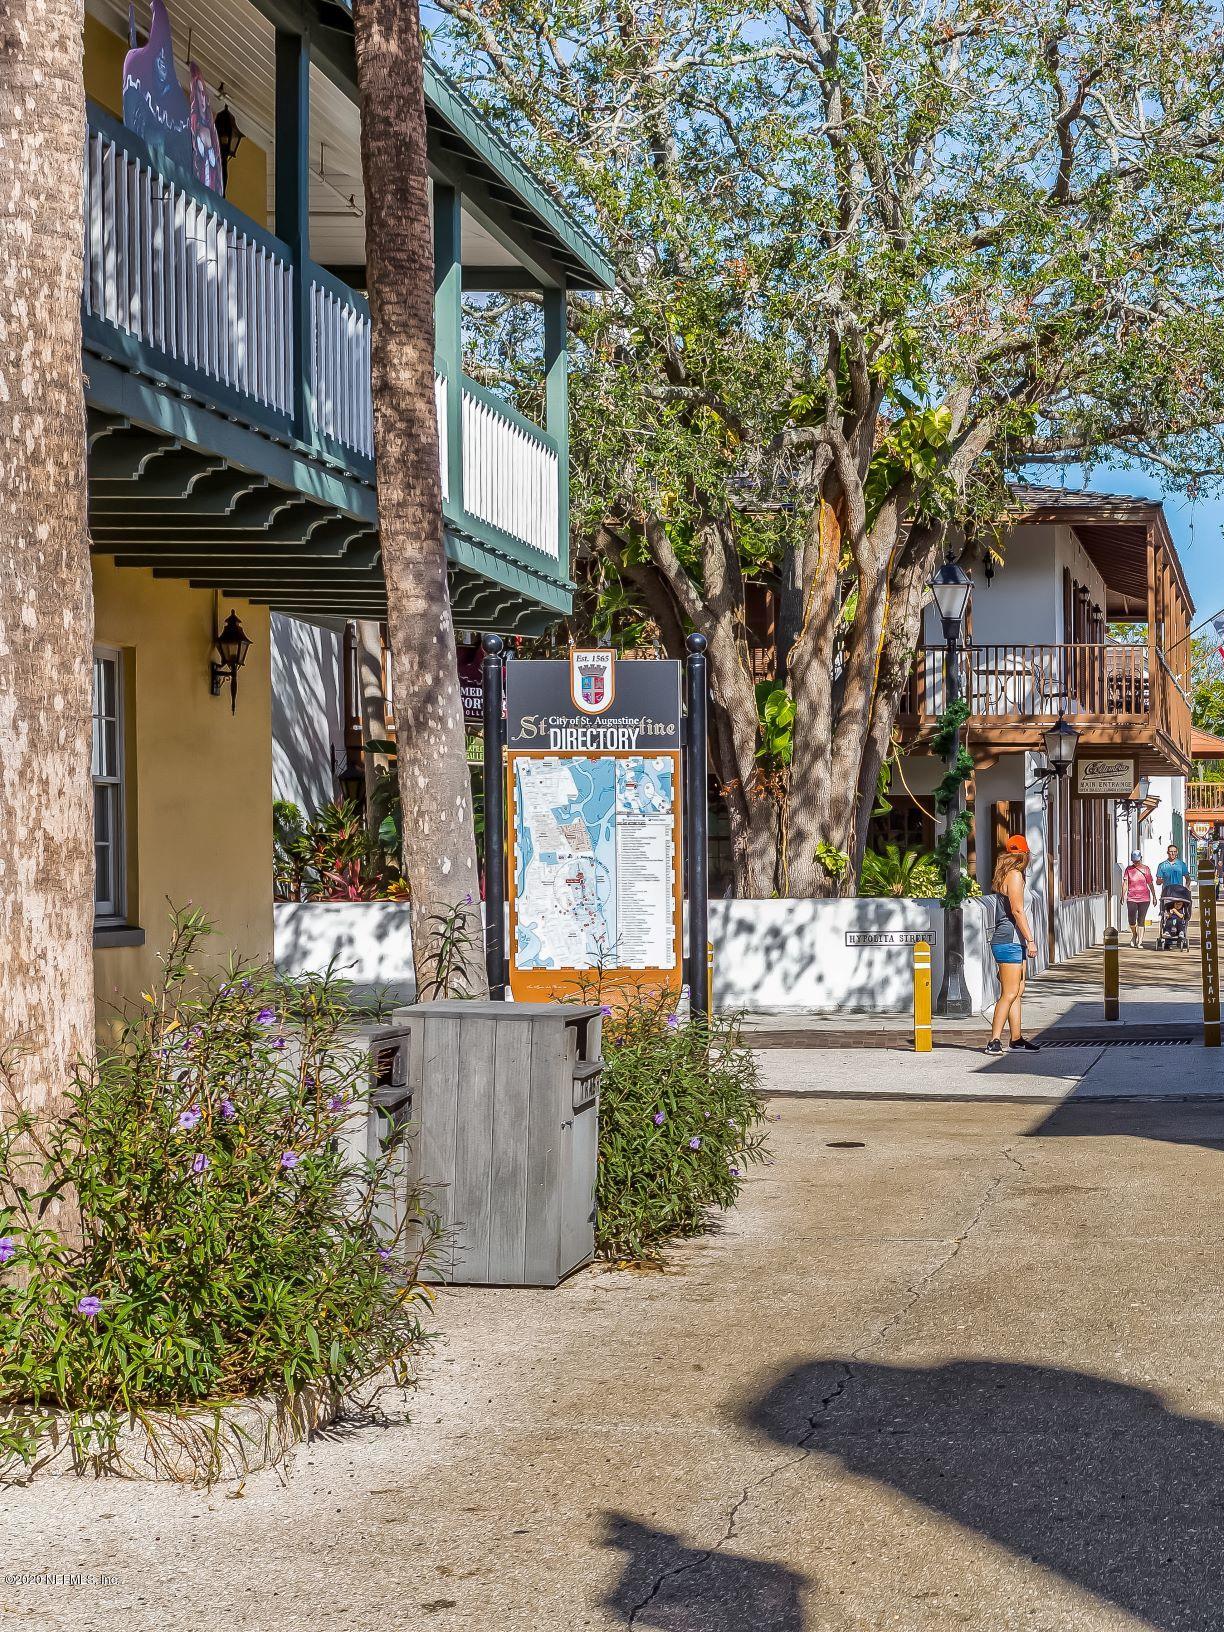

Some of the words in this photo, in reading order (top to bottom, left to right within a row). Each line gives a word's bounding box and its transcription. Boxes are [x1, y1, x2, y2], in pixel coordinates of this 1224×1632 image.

[576, 654, 589, 662] Est.
[592, 654, 610, 662] 1565
[549, 716, 568, 727] City
[569, 716, 580, 725] of
[581, 717, 592, 725] St.
[594, 716, 640, 728] Augustine
[550, 728, 640, 750] DIRECTORY
[849, 935, 894, 943] HYPOLITA
[899, 934, 933, 943] STREET
[1204, 907, 1214, 995] HYPOLITA
